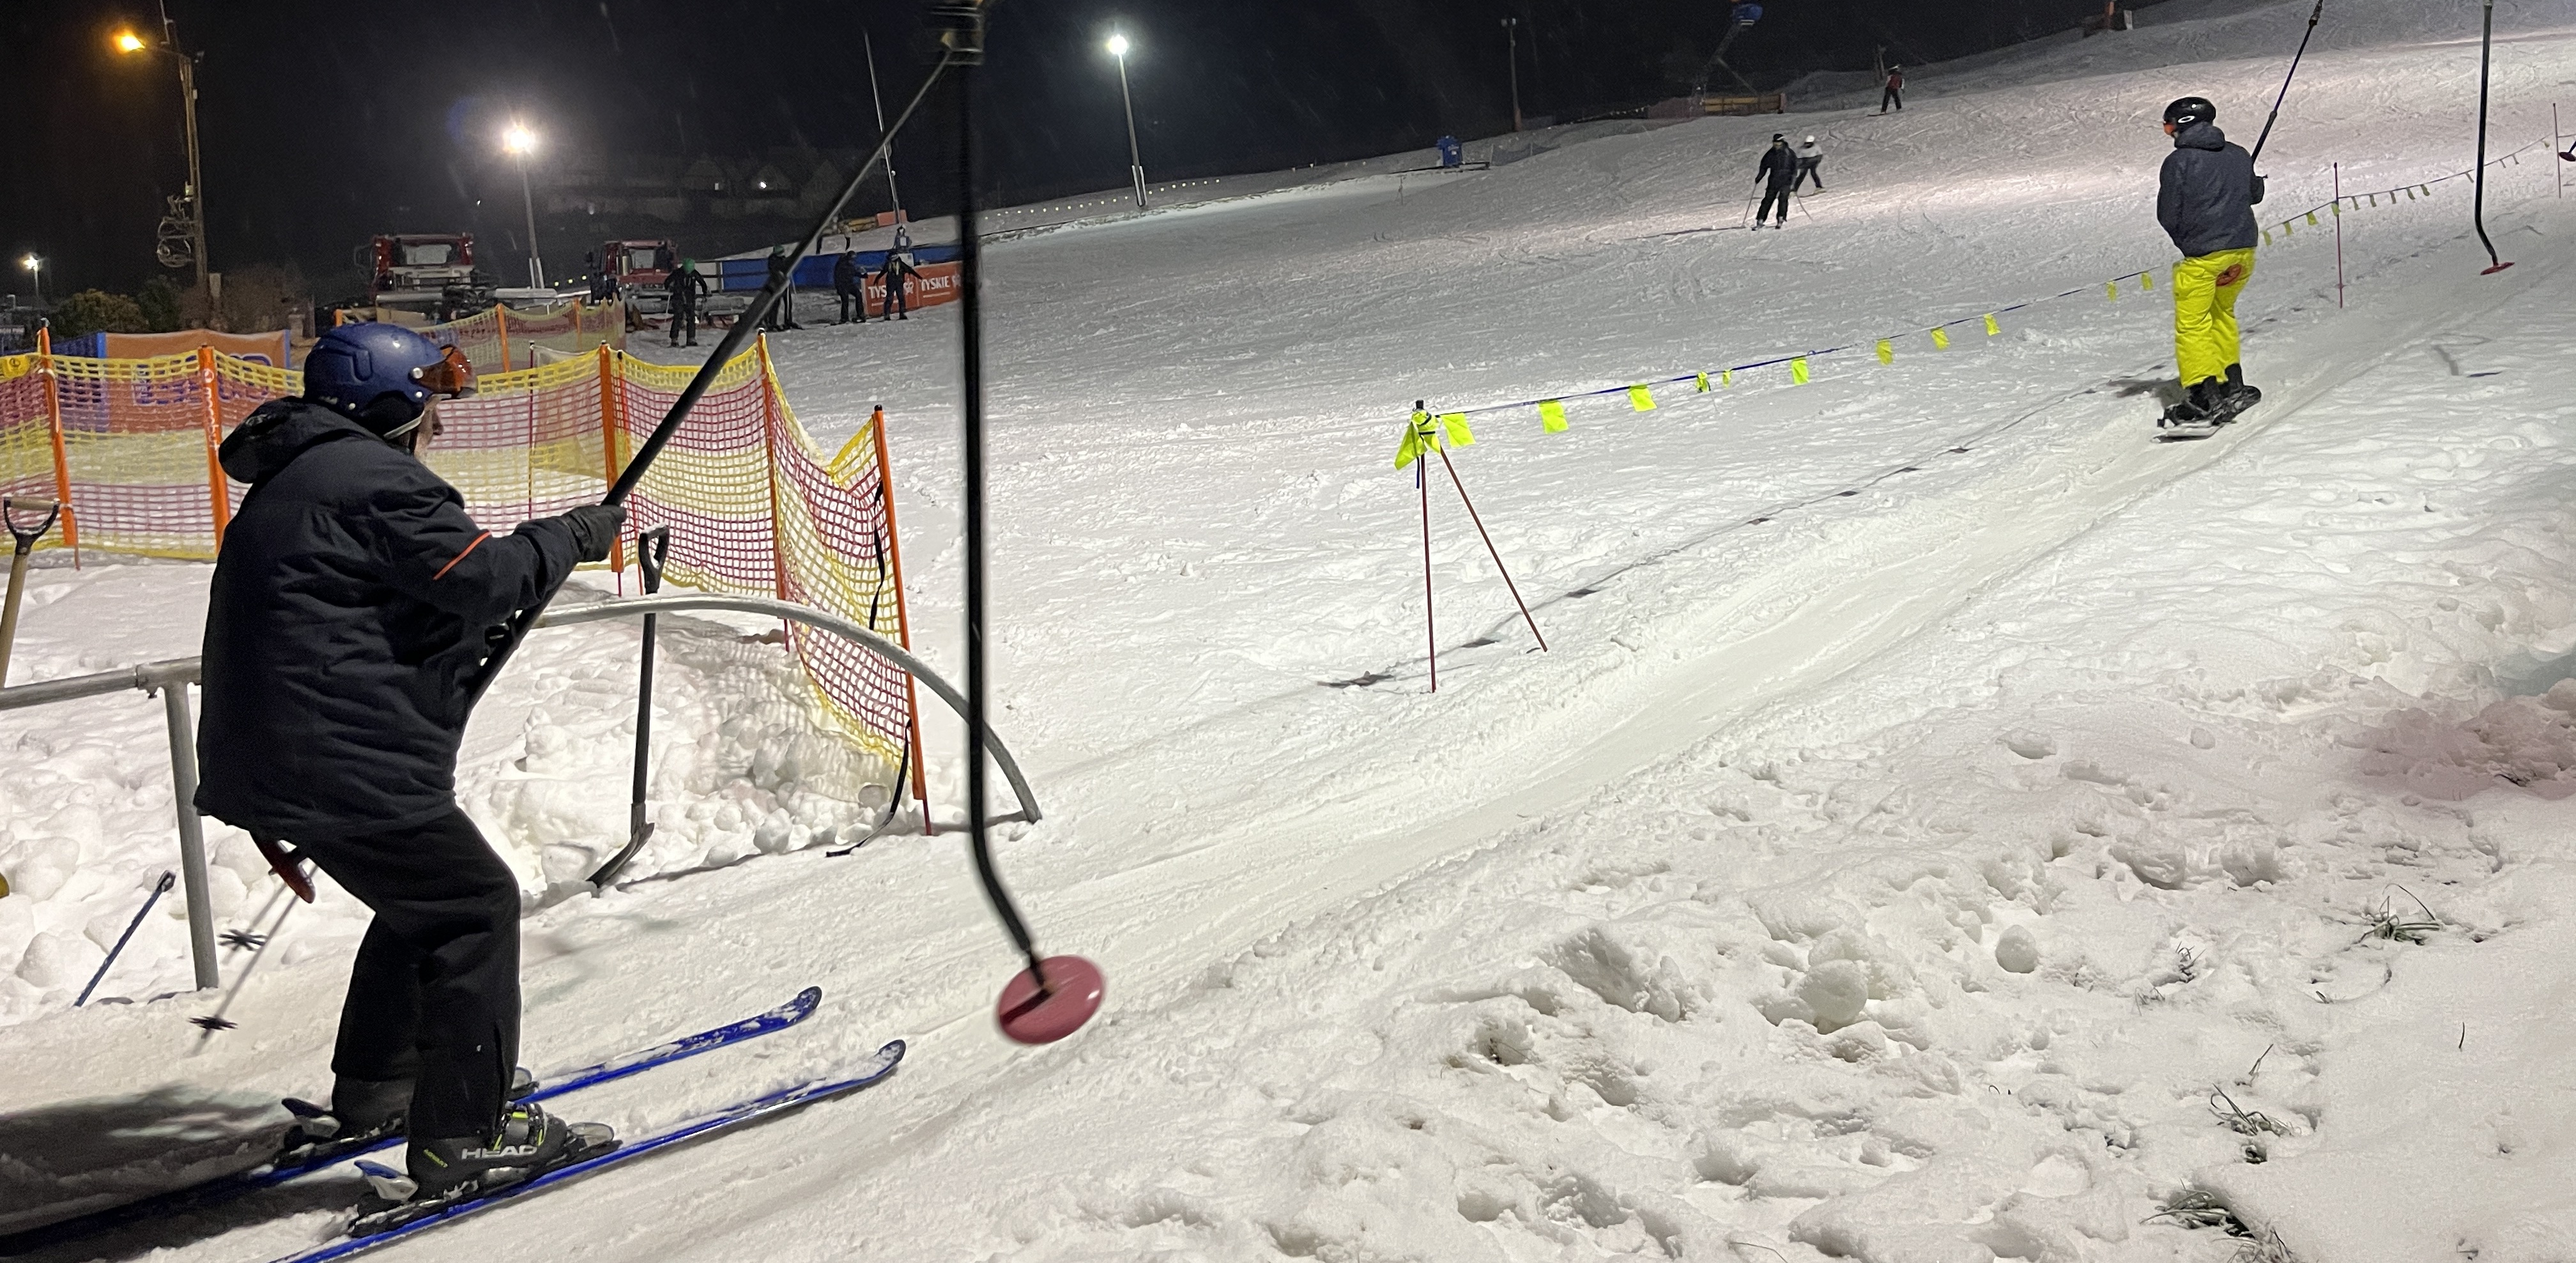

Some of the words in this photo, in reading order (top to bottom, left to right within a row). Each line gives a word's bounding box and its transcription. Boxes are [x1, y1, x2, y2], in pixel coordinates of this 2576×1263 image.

[921, 276, 950, 291] TYSKIE
[869, 286, 896, 298] TYS
[461, 1145, 537, 1160] HEAD
